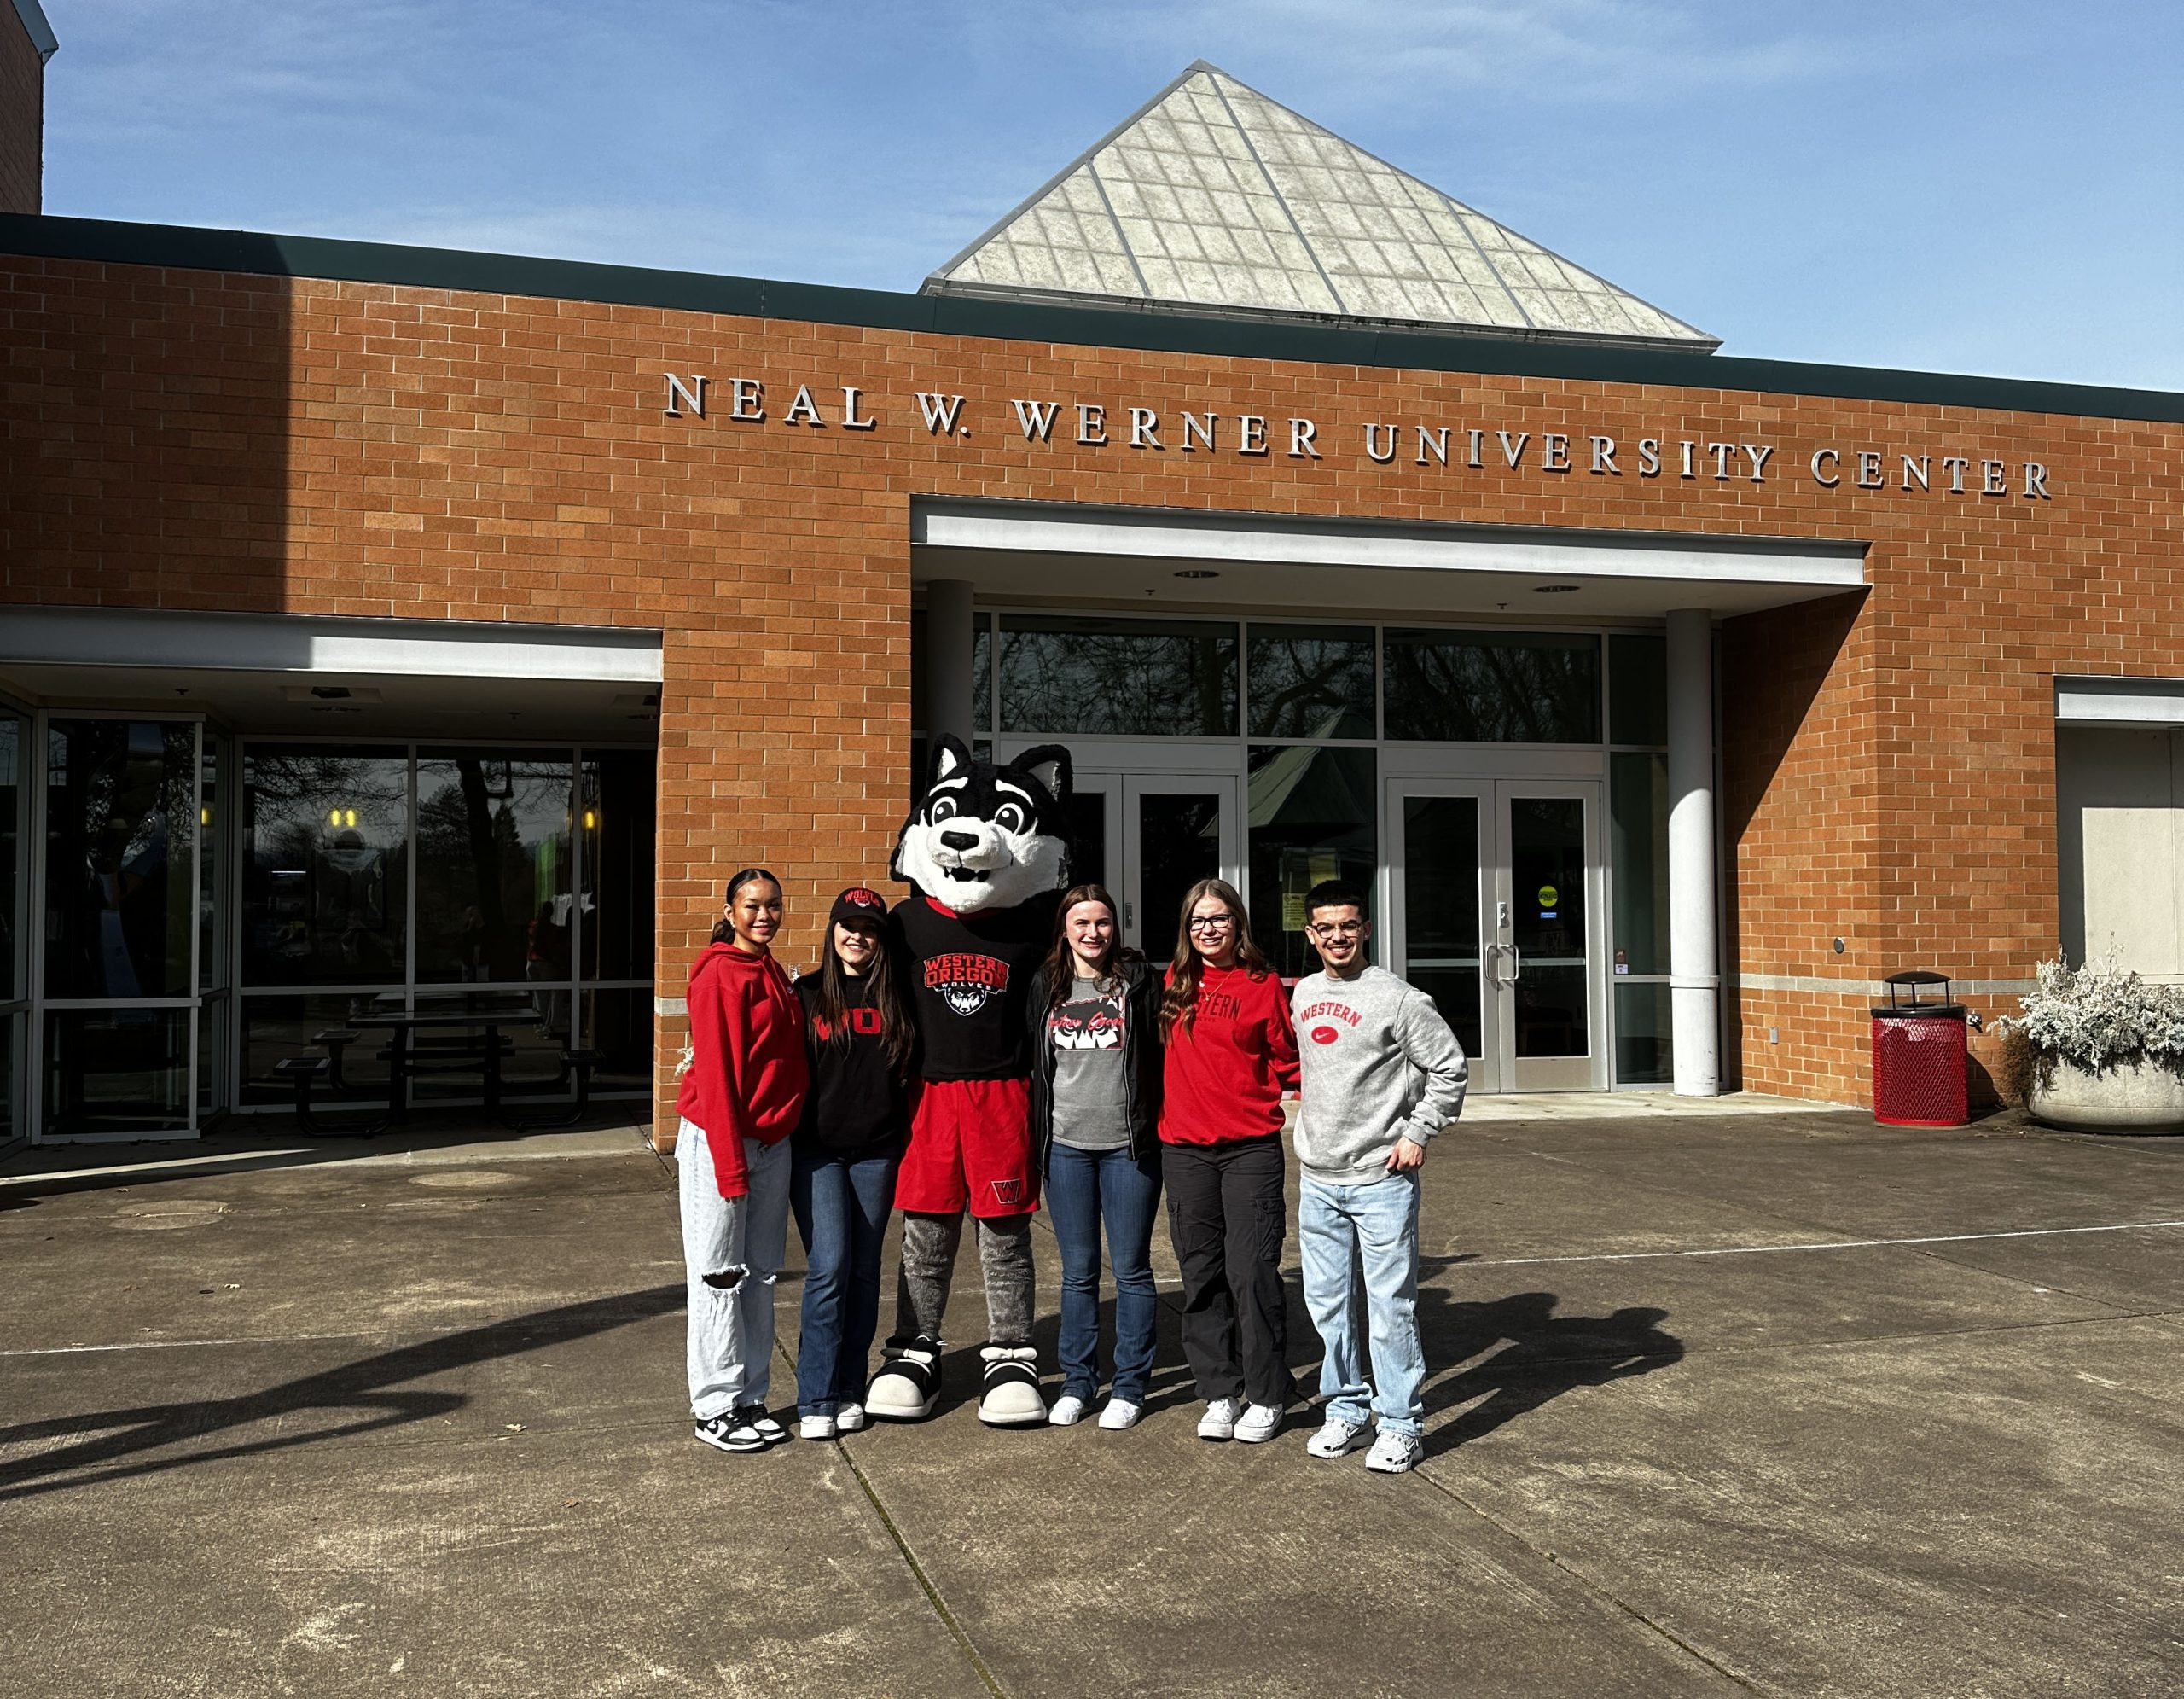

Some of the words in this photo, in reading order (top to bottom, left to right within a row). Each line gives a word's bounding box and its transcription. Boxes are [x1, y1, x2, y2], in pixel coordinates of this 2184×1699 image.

[663, 373, 875, 428] NEAL
[915, 392, 969, 435] W.
[1011, 399, 1321, 457] WERNER
[1363, 422, 1774, 480] UNIVERSITY
[1810, 449, 2050, 497] CENTER
[926, 954, 1007, 975] WESTERN
[926, 967, 1006, 989] OREGON
[941, 981, 991, 991] WOLVES
[1300, 1002, 1362, 1027] WESTERN
[990, 1178, 1021, 1204] W
